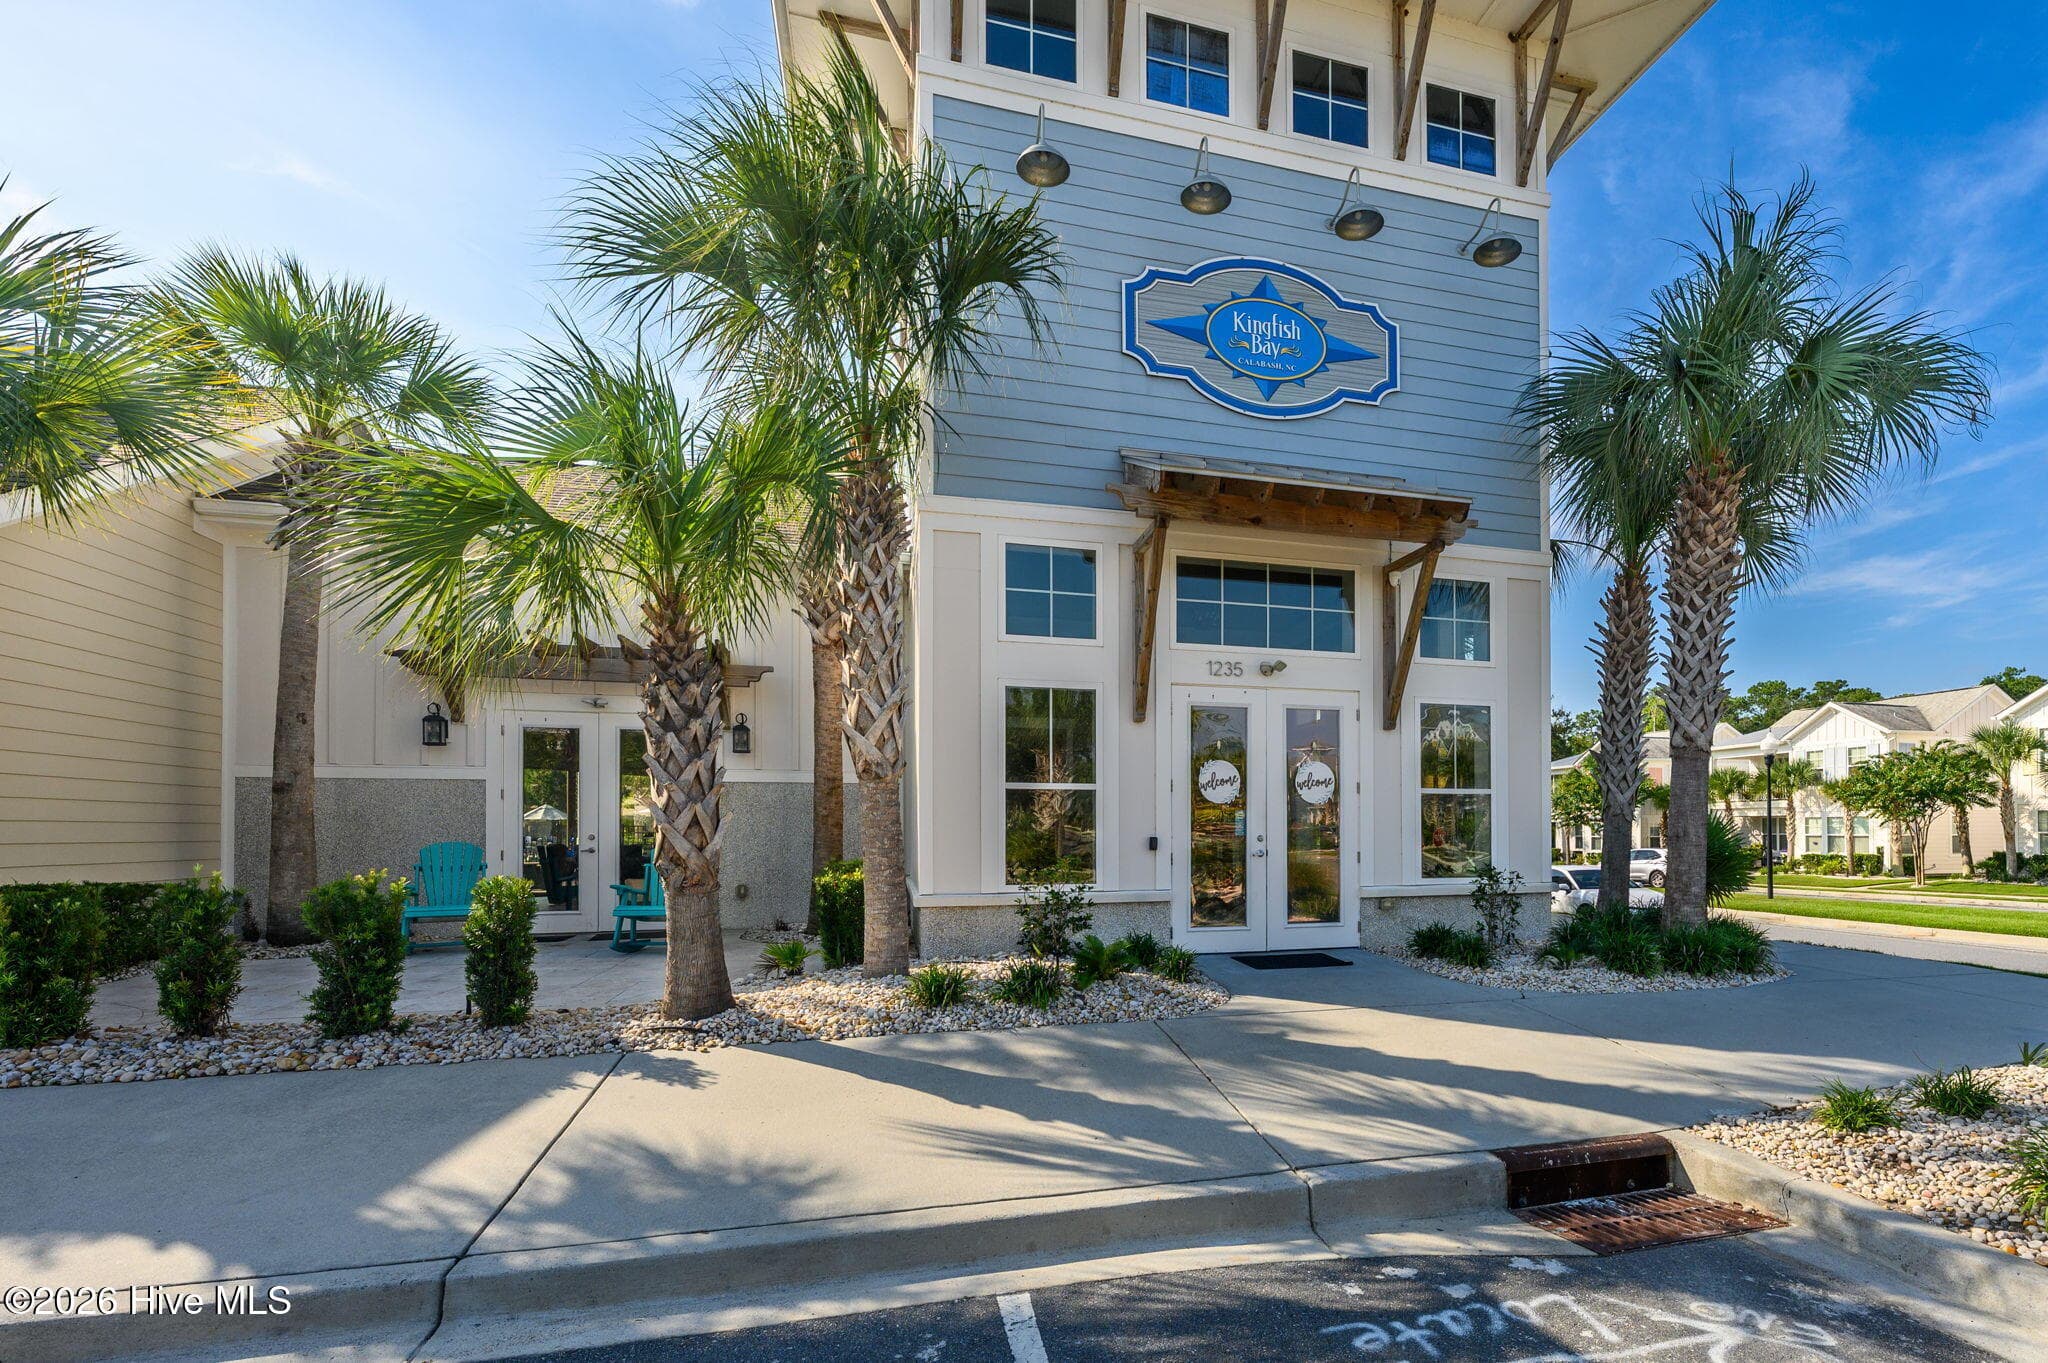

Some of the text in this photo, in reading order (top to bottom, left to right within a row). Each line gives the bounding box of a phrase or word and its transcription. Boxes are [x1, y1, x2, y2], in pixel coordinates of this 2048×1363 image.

[1233, 311, 1301, 341] Kingfish
[1251, 333, 1281, 360] Bay
[1238, 357, 1297, 372] CALABASH, NC
[1206, 660, 1244, 678] 1235
[1200, 771, 1239, 791] welcome
[1296, 772, 1334, 790] welcome
